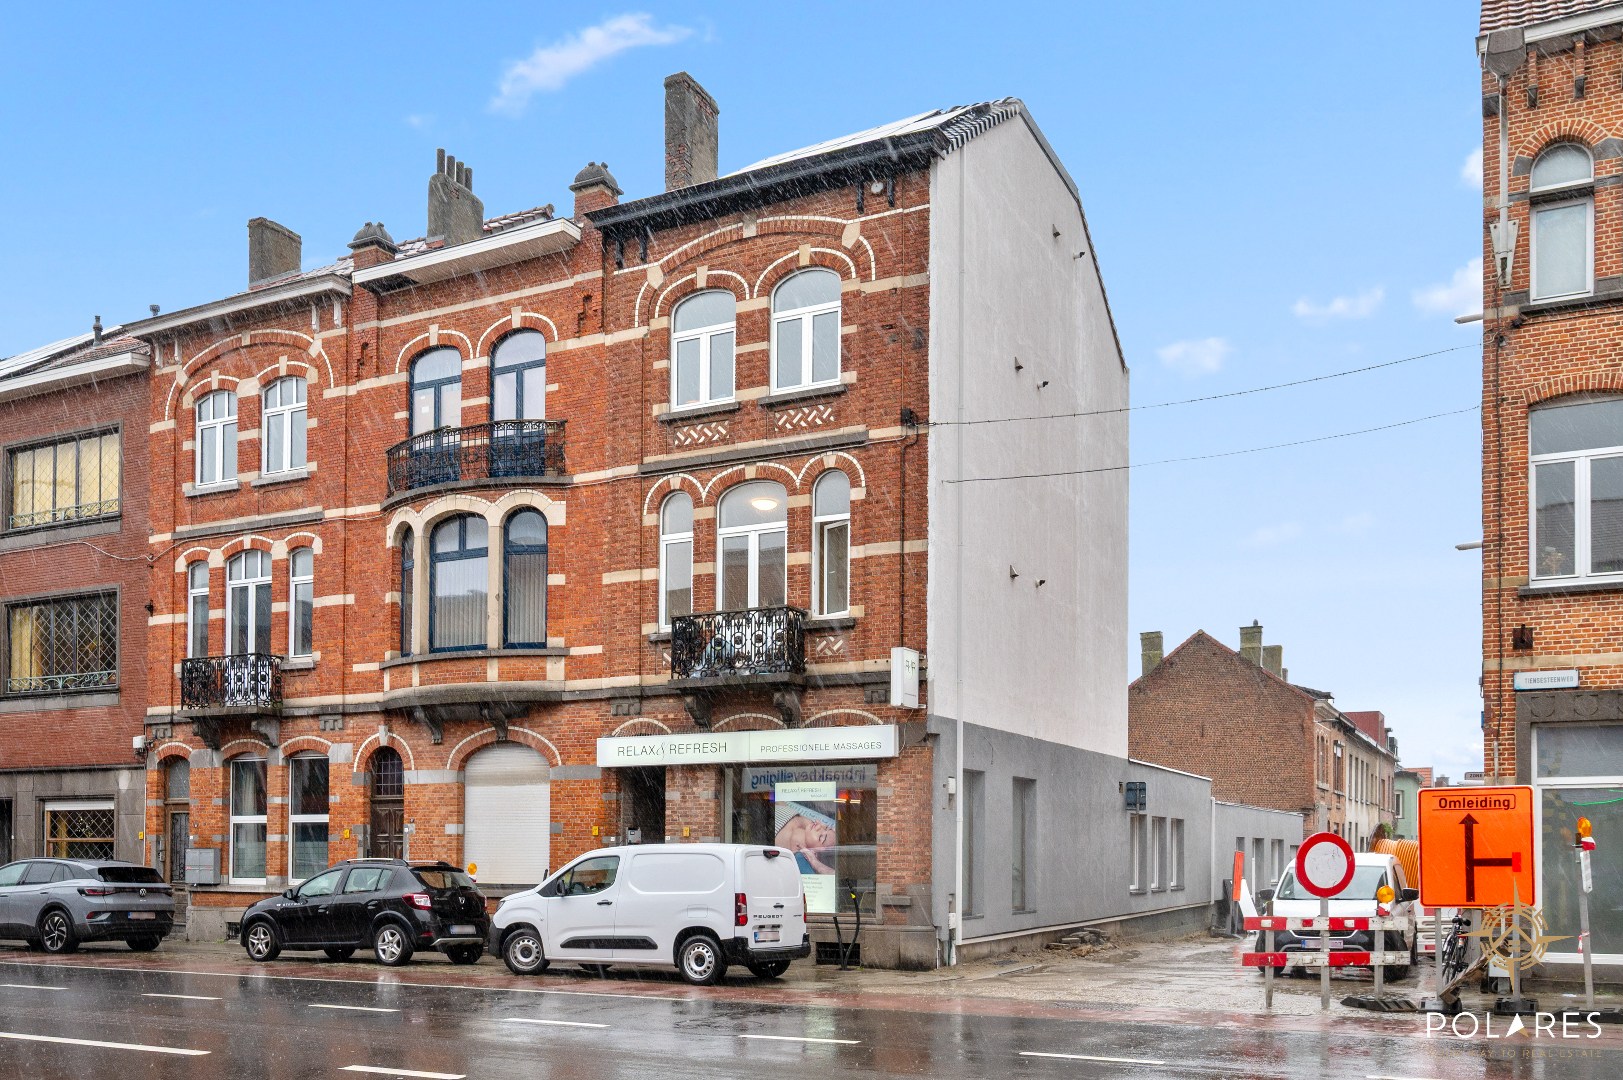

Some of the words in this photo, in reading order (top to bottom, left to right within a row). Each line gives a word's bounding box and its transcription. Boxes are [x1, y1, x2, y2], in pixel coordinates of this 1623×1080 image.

[617, 745, 656, 757] RELAX
[669, 742, 727, 755] REFRESH
[760, 743, 830, 753] PROFESSIONELE
[833, 741, 882, 750] MASSAGES
[1438, 797, 1511, 811] Omleiding
